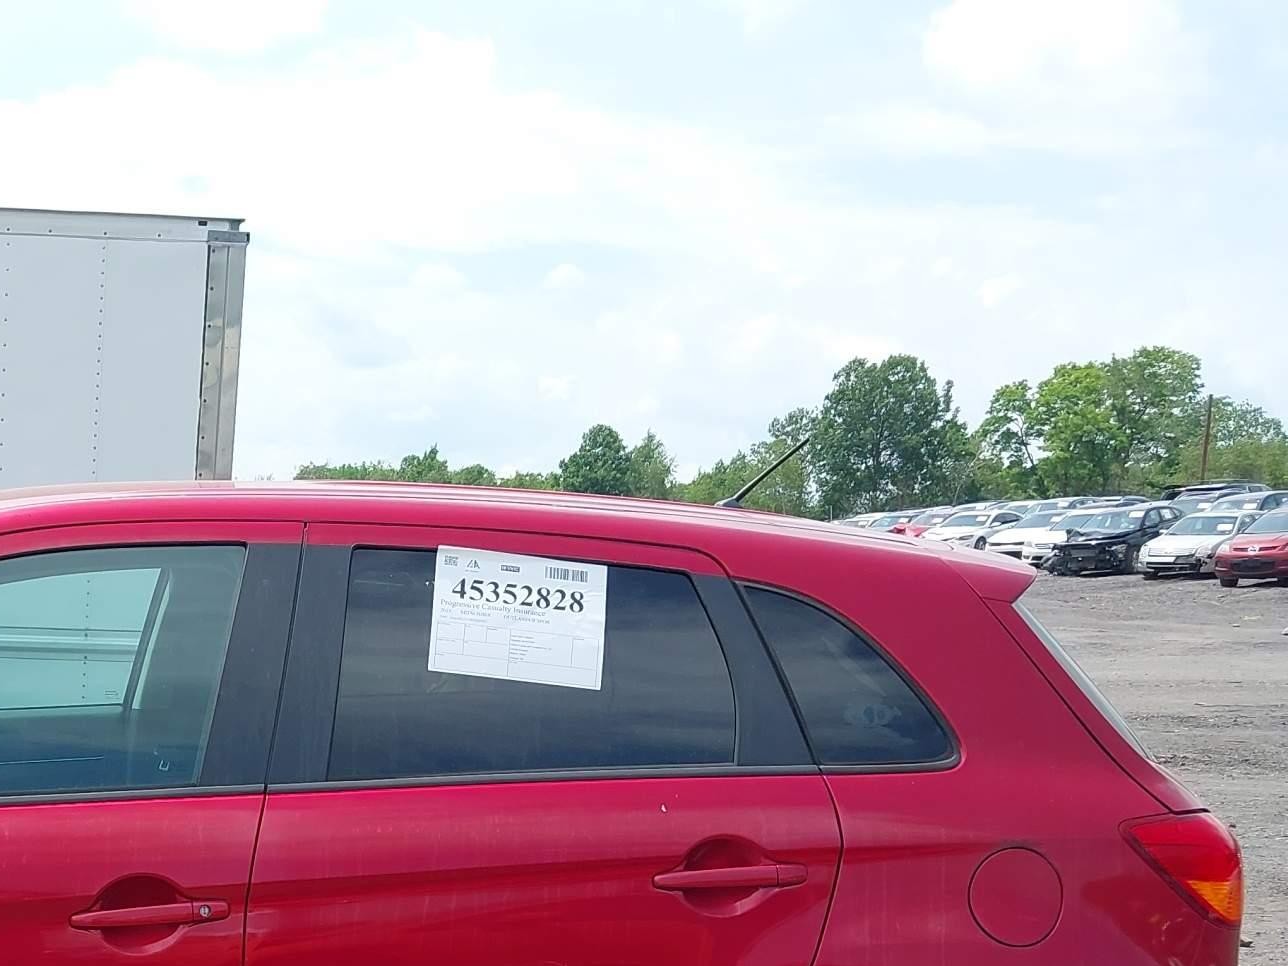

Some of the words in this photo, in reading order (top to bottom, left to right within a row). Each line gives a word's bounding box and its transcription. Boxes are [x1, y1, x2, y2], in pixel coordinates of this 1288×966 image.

[452, 577, 584, 613] 45352828
[481, 603, 512, 615] Casualty
[513, 606, 547, 618] Insurance
